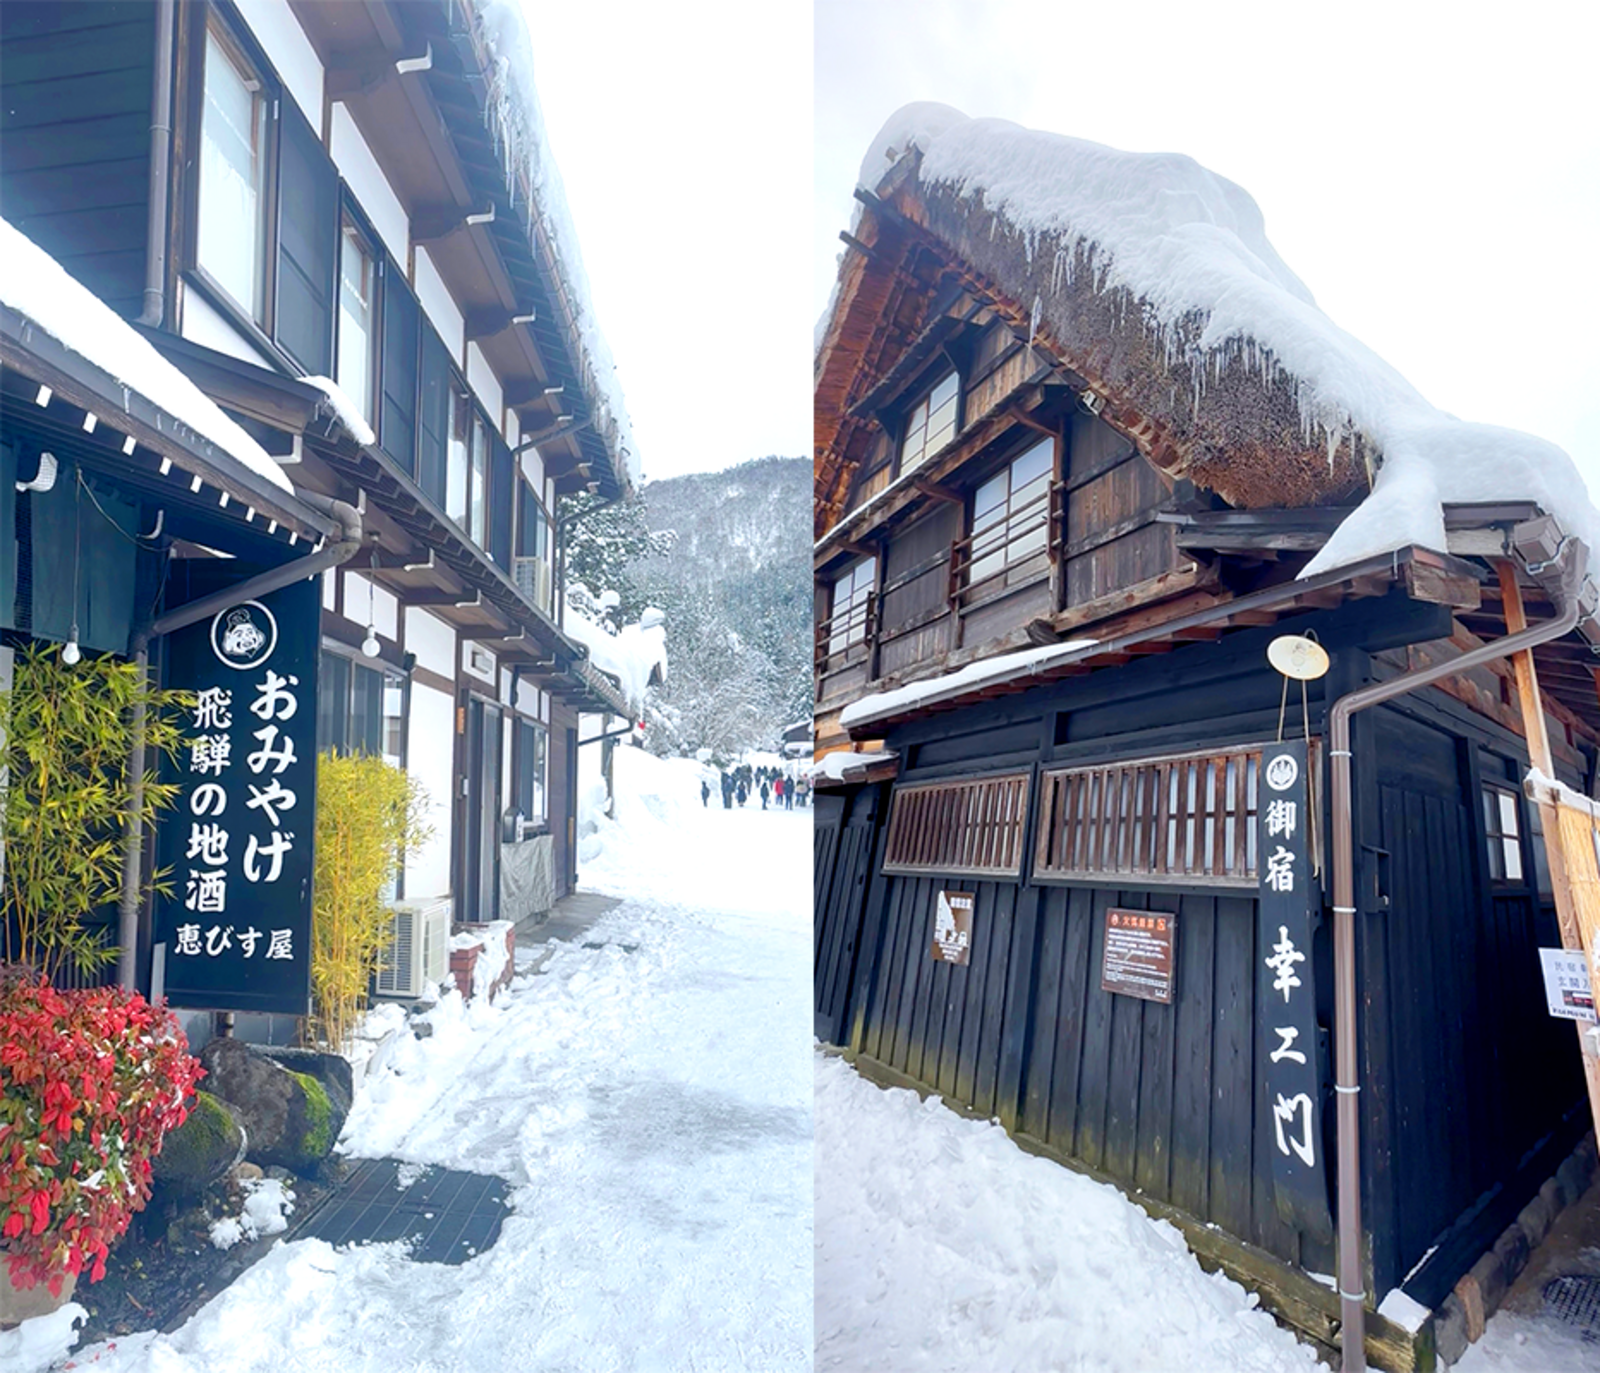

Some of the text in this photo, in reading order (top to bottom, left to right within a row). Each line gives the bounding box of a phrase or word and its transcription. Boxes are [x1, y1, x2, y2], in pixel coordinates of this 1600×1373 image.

[187, 687, 232, 911] 飛騨の地酒
[244, 670, 298, 881] おみやげ
[1265, 800, 1297, 892] 御宿
[175, 924, 294, 960] 恵びす屋
